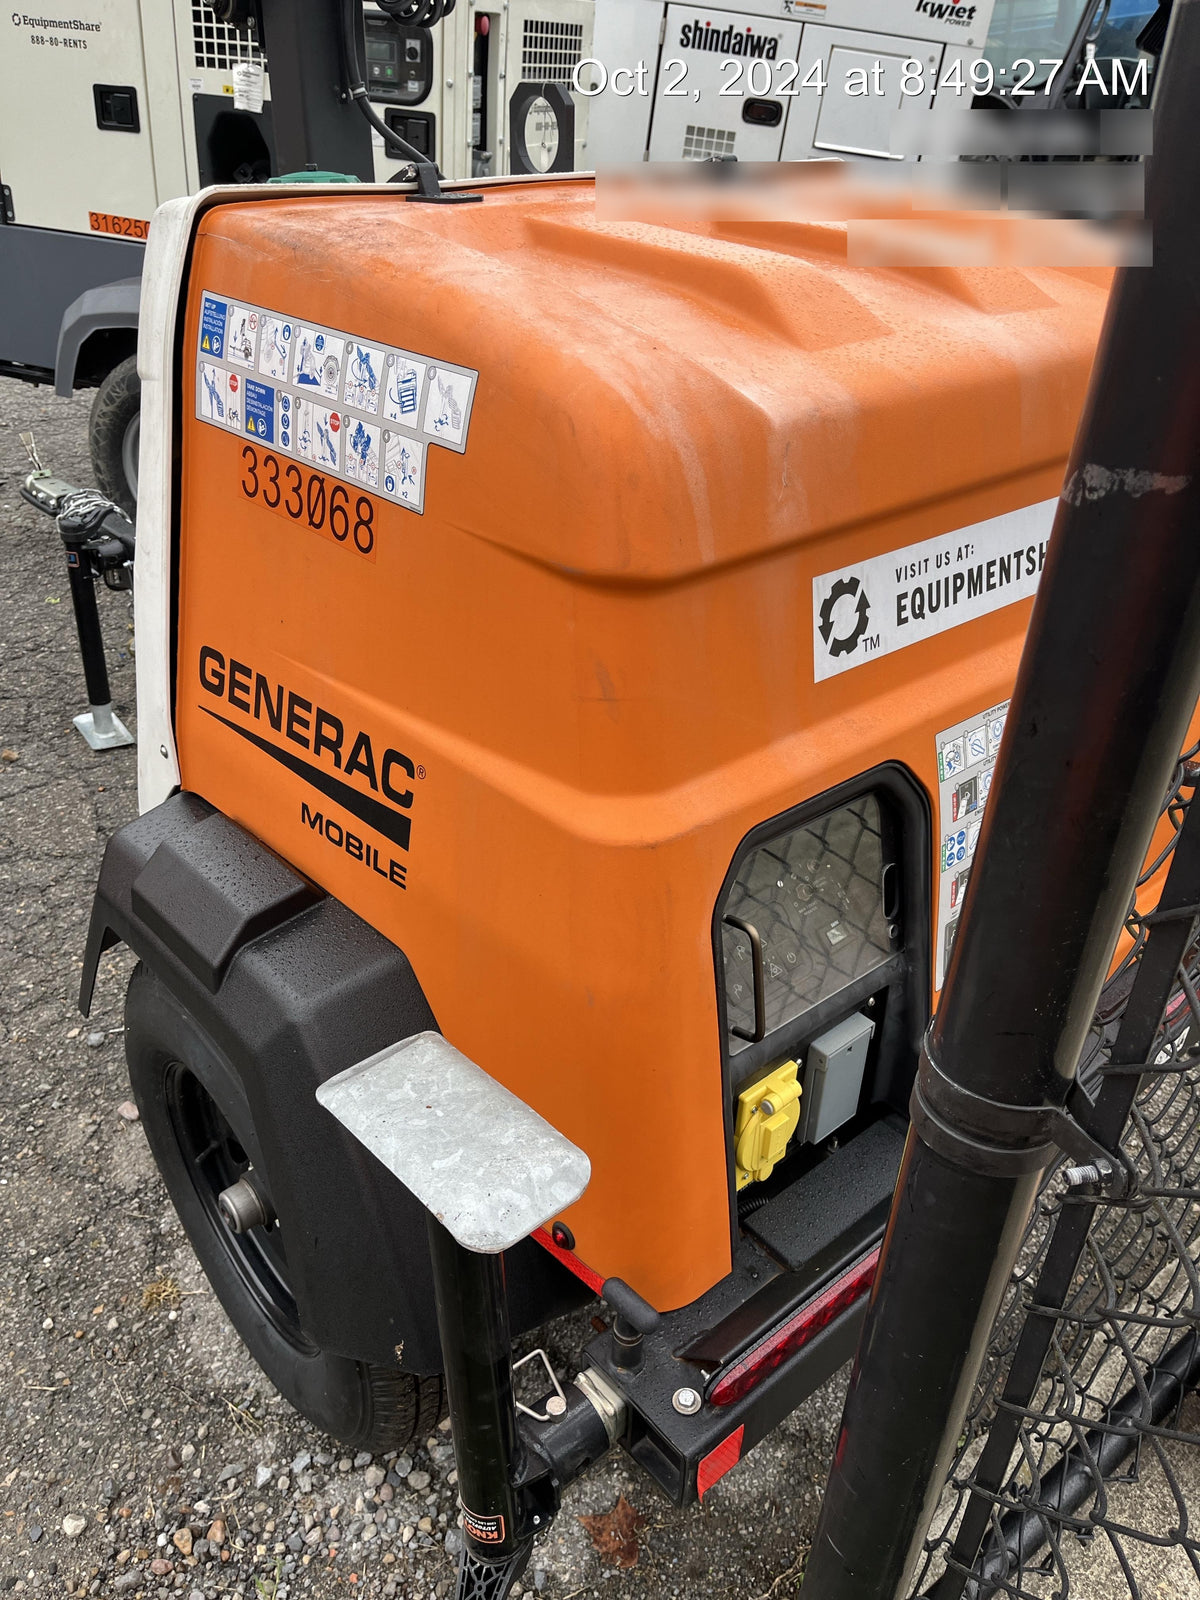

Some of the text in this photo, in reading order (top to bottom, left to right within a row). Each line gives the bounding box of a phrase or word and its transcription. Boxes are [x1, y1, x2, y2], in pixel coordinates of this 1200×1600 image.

[22, 15, 102, 32] EquipmentShare
[31, 35, 88, 49] 888-80-RENTS
[680, 19, 779, 60] shindaiwa
[895, 543, 974, 583] VISIT US AT:
[301, 802, 408, 891] MOBILE
